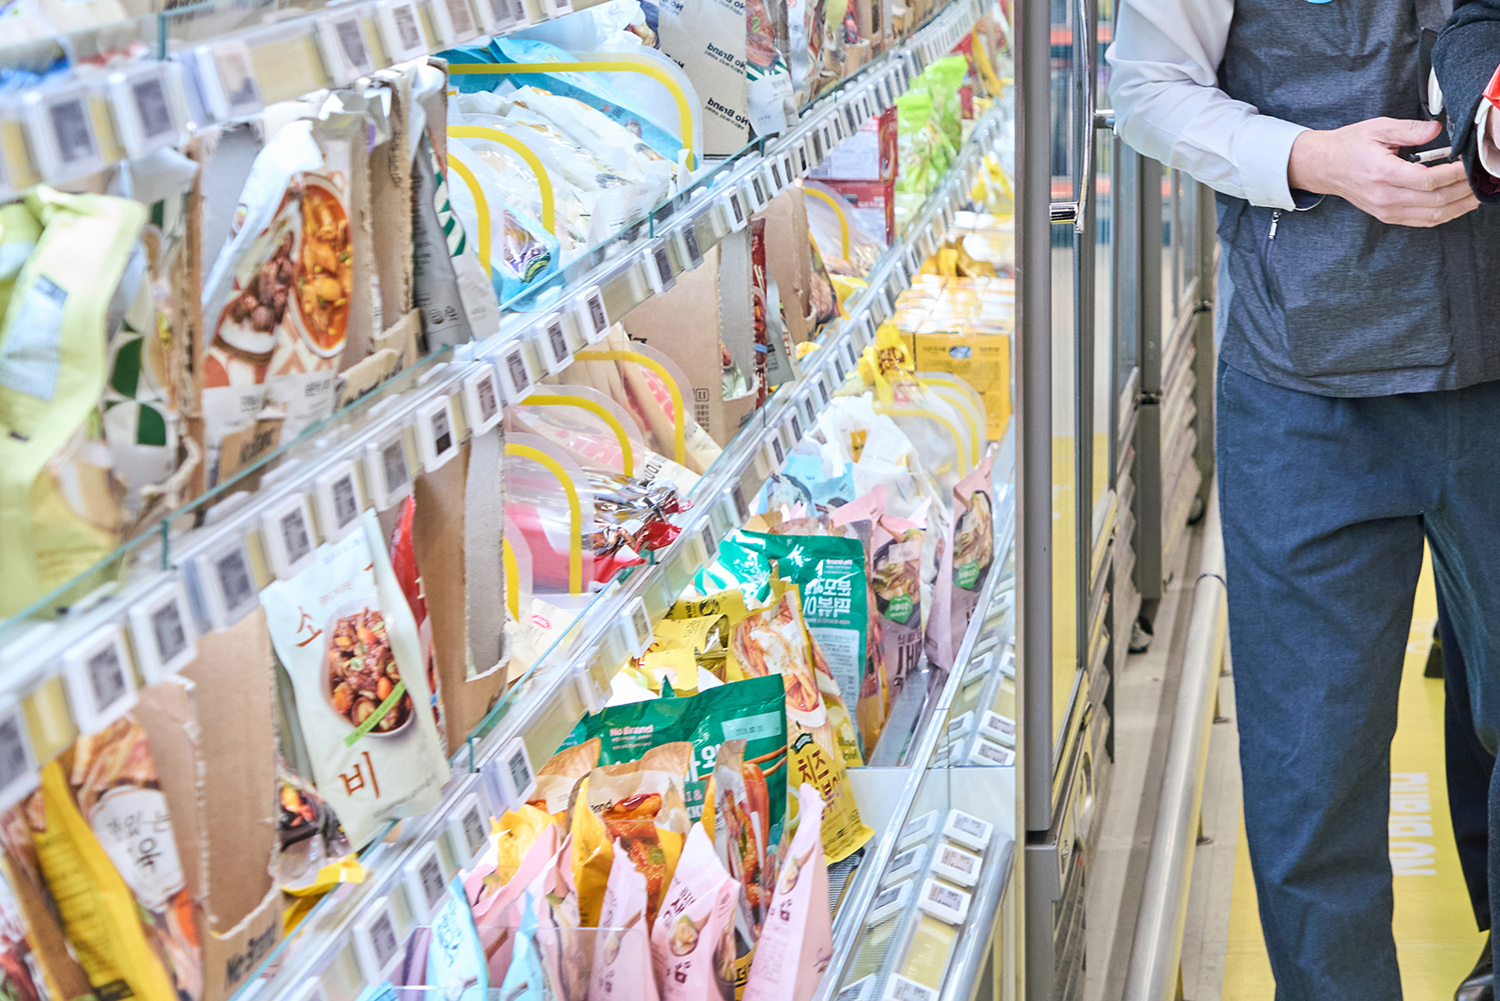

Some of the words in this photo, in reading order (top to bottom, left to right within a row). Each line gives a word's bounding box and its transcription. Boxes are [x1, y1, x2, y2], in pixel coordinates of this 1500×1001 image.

[610, 726, 623, 736] No
[624, 724, 654, 736] Brand
[799, 749, 829, 784] 치즈
